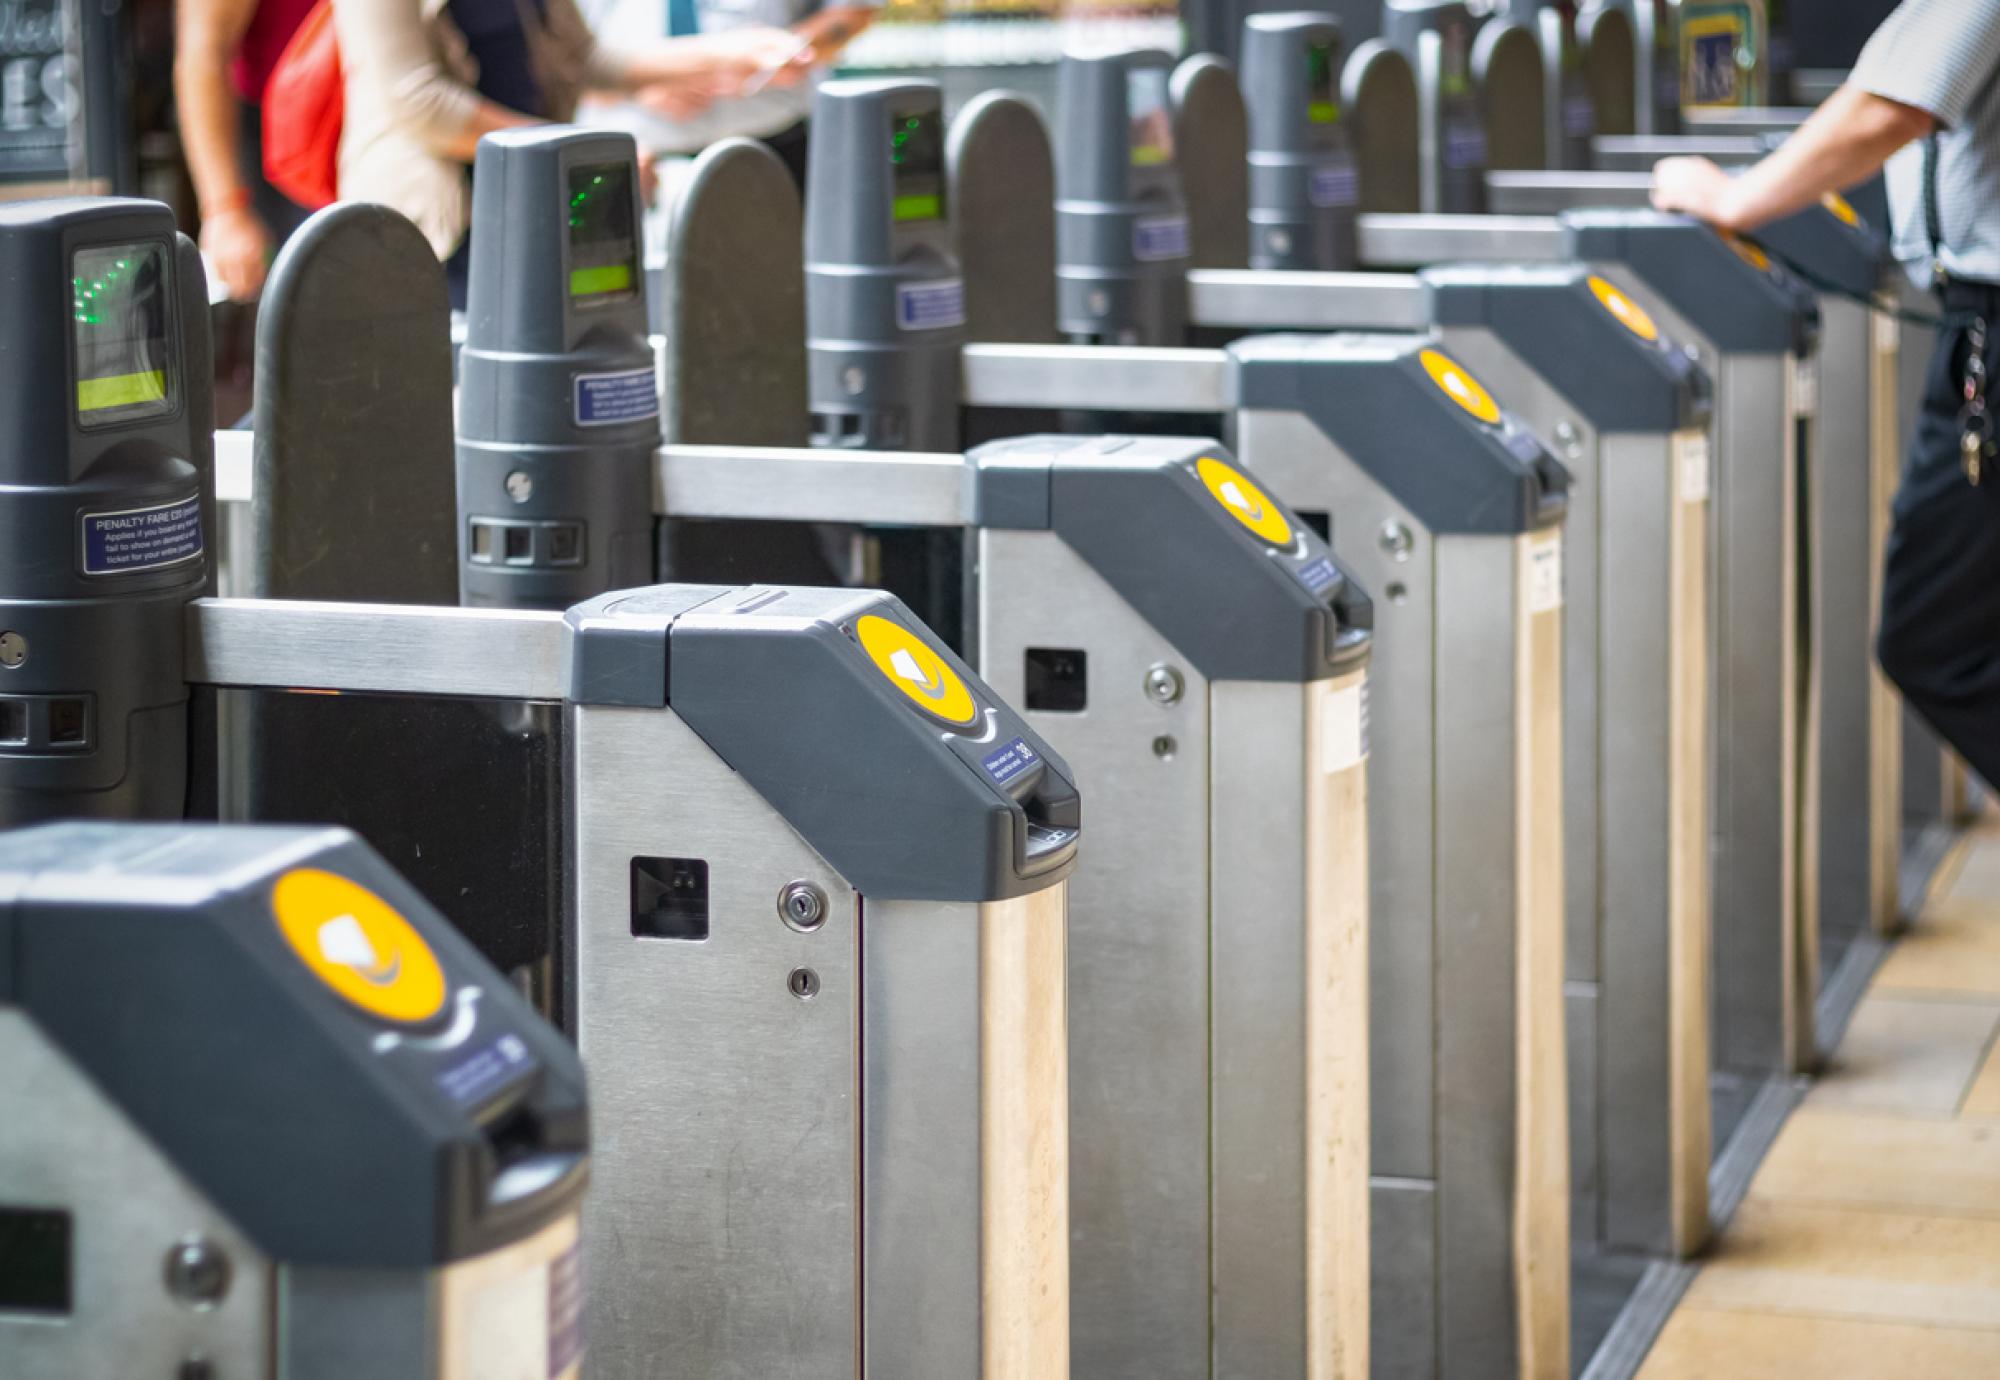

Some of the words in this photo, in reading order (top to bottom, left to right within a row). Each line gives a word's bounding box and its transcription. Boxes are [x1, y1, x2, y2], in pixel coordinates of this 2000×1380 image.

[96, 517, 144, 531] PENALTY
[148, 512, 169, 525] FARE
[105, 532, 136, 542] Applies
[145, 529, 158, 539] you
[105, 544, 120, 553] fail
[120, 543, 129, 552] to
[130, 541, 151, 551] show
[106, 555, 130, 565] ticket
[131, 553, 142, 562] for
[143, 550, 160, 562] your
